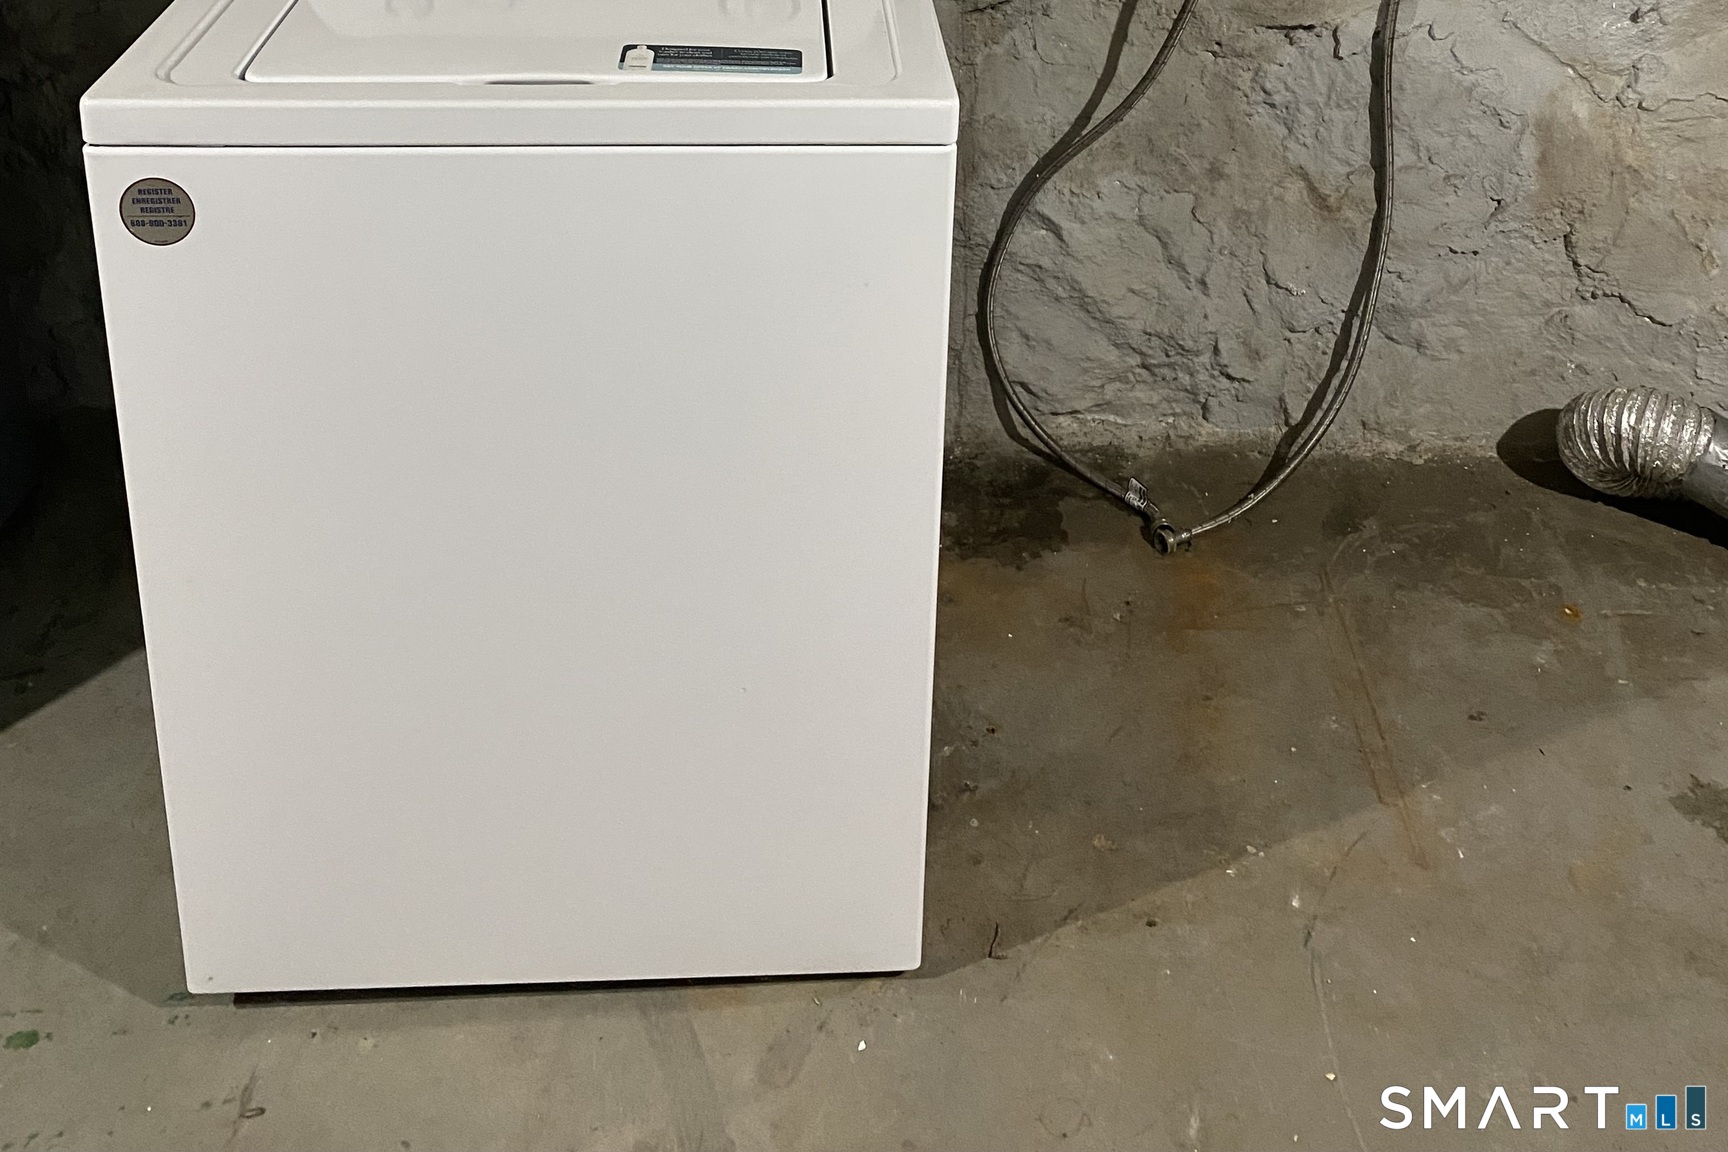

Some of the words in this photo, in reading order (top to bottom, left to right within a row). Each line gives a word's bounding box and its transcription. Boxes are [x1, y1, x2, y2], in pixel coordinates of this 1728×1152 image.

[137, 188, 173, 196] REGISTER
[132, 197, 182, 205] ENREGISTRER
[139, 206, 175, 214] REGISTRE
